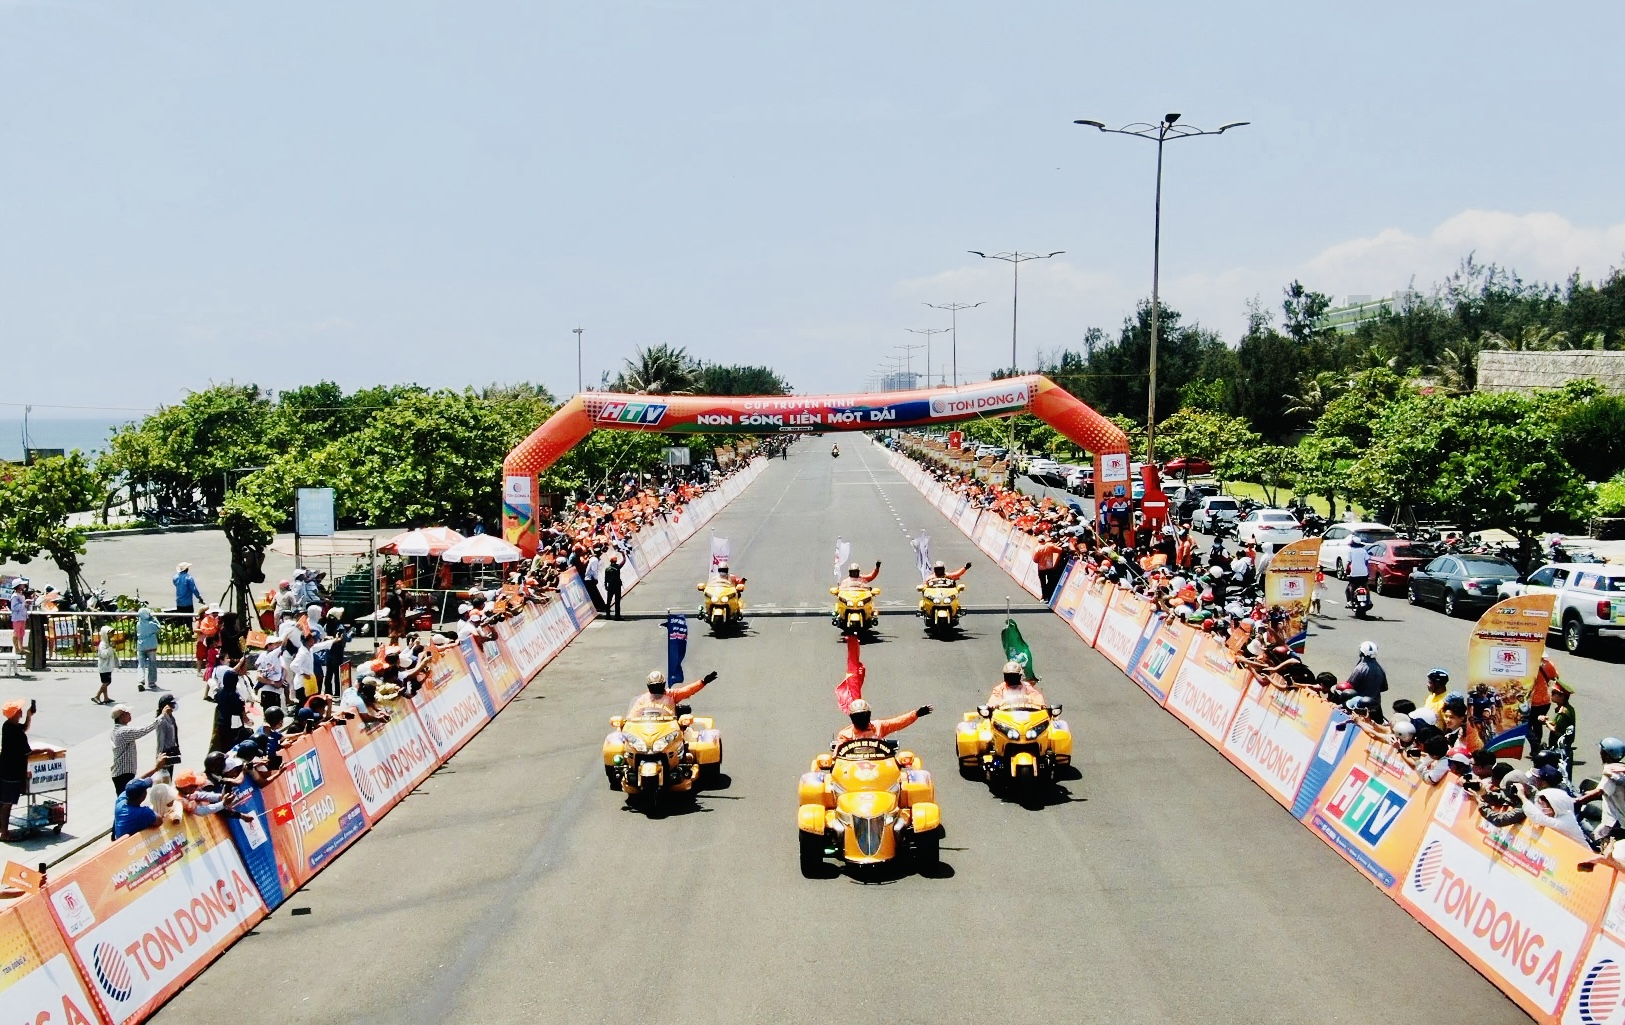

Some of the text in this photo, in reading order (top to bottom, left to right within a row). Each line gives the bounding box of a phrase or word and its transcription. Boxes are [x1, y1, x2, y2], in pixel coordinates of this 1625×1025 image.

[600, 403, 663, 422] HTV
[698, 414, 732, 425] NON
[740, 412, 783, 426] SÔNG
[827, 410, 863, 424] MỘT
[948, 391, 1025, 412] TON DONG A
[1143, 640, 1175, 678] HTV
[438, 691, 483, 739] TON DONG A
[1181, 681, 1229, 732] TON DONG A
[286, 753, 321, 798] HTV
[369, 734, 431, 794] TON DONG A
[1241, 724, 1301, 790] TON DONG A
[310, 794, 335, 824] THAO
[1329, 771, 1403, 839] HTV
[125, 919, 183, 981] TON
[174, 879, 236, 947] DONG
[232, 869, 253, 904] A
[1434, 867, 1562, 997] TON DONG A
